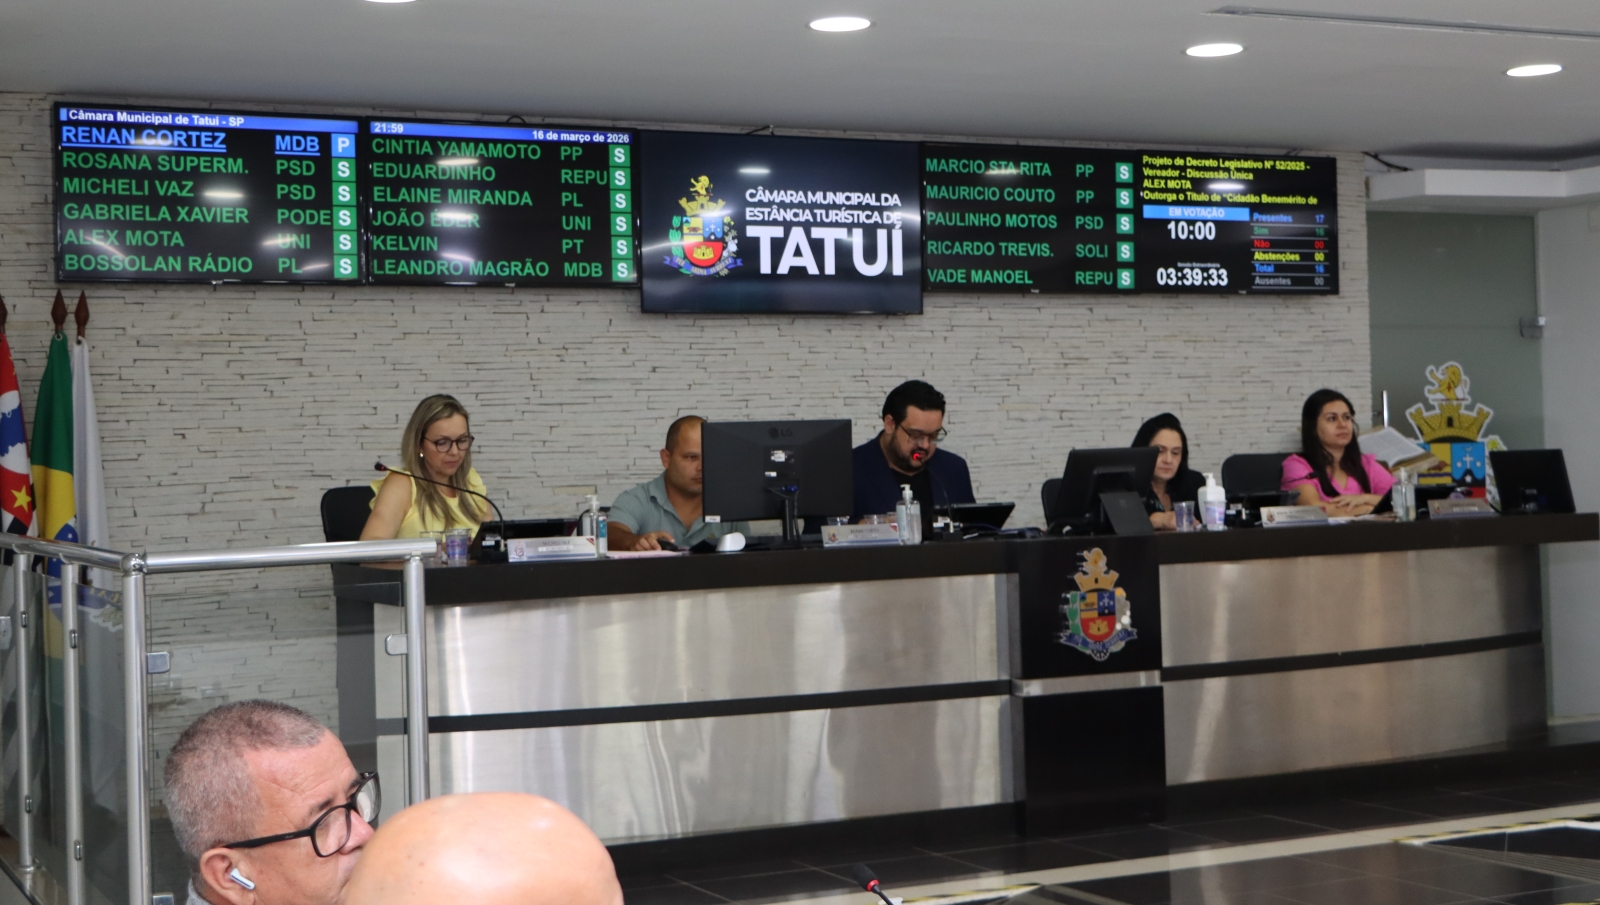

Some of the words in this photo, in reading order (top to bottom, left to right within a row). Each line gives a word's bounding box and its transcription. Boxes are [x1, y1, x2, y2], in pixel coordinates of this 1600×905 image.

[69, 110, 114, 122] Câmara
[117, 112, 172, 125] Municipal
[175, 114, 189, 124] de
[228, 117, 244, 127] SP
[374, 122, 404, 133] 21:59
[62, 126, 135, 144] RENAN
[142, 130, 226, 148] CORTEZ
[276, 136, 320, 152] MDB
[338, 138, 350, 152] P
[532, 131, 544, 139] 16
[546, 131, 558, 139] de
[560, 133, 590, 143] março
[593, 133, 604, 142] de
[607, 134, 629, 143] 2026
[372, 138, 433, 155] CINTIA
[437, 141, 541, 159] YAMAMOTO
[561, 146, 582, 161] PP
[614, 148, 625, 163] S
[63, 152, 152, 170] ROSANA
[158, 156, 248, 174] SUPERM.
[276, 160, 316, 176] PSD
[338, 162, 350, 177] S
[926, 158, 985, 173] MARCIO
[989, 161, 1016, 174] STA
[1020, 162, 1051, 176] RITA
[1076, 164, 1094, 177] PP
[1120, 165, 1129, 179] S
[1143, 155, 1172, 166] Projeto
[1174, 157, 1184, 166] de
[1186, 157, 1218, 167] Decreto
[1220, 158, 1263, 170] Legislativo
[1276, 161, 1305, 170] 52/2025
[373, 162, 496, 181] EDUARDINHO
[561, 170, 608, 185] REPU
[615, 171, 626, 186] S
[1142, 167, 1180, 176] Vereador
[1186, 169, 1229, 179] Discussão
[63, 178, 148, 196] MICHELI
[155, 180, 194, 196] VAZ
[276, 184, 316, 200] PSD
[338, 186, 350, 202] S
[1143, 179, 1166, 188] ALEX
[1167, 179, 1192, 189] MOTA
[373, 187, 442, 203] ELAINE
[448, 189, 532, 206] MIRANDA
[562, 193, 583, 207] PL
[615, 194, 626, 208] S
[746, 186, 806, 204] CÂMARA
[808, 190, 880, 206] MUNICIPAL
[881, 194, 901, 206] DA
[926, 185, 999, 200] MAURICIO
[1004, 188, 1055, 202] COUTO
[1076, 190, 1094, 203] PP
[1120, 191, 1129, 205] S
[1144, 191, 1177, 202] Outorga
[1211, 193, 1221, 201] de
[1262, 194, 1306, 204] Benemérito
[1308, 196, 1318, 204] de
[63, 203, 171, 221] GABRIELA
[177, 206, 248, 223] XAVIER
[277, 208, 332, 225] PODE
[339, 210, 350, 226] S
[373, 209, 424, 226] JOÃO
[431, 209, 480, 228] ÉDER
[562, 216, 591, 230] UNI
[616, 217, 627, 232] S
[746, 206, 812, 222] ESTÂNCIA
[814, 208, 882, 224] TURÍSTICA
[883, 212, 901, 224] DE
[927, 212, 1001, 227] PAULINHO
[1006, 214, 1057, 228] MOTOS
[1076, 216, 1104, 230] PSD
[1120, 217, 1130, 230] S
[1169, 208, 1181, 216] EM
[1184, 206, 1225, 218] VOTAÇÃO
[1253, 212, 1293, 222] Presentes
[1315, 214, 1325, 223] 17
[1168, 220, 1216, 240] 10:00
[1253, 226, 1269, 235] Sim
[64, 229, 119, 246] ALEX
[126, 230, 184, 247] MOTA
[278, 234, 310, 249] UNI
[339, 234, 351, 250] S
[373, 236, 438, 251] KELVIN
[563, 239, 583, 254] PT
[616, 240, 627, 255] S
[1254, 239, 1270, 248] Não
[1314, 240, 1324, 249] 00
[746, 222, 903, 276] TATUÍ
[927, 240, 995, 255] RICARDO
[999, 242, 1054, 257] TREVIS.
[1076, 244, 1108, 258] SOLI
[1121, 245, 1130, 258] S
[1254, 251, 1300, 262] Abstenções
[1314, 252, 1324, 262] 00
[64, 254, 182, 272] BOSSOLAN
[188, 252, 253, 273] RÁDIO
[279, 258, 302, 273] PL
[340, 258, 352, 274] S
[373, 259, 463, 275] LEANDRO
[469, 258, 549, 277] MAGRÃO
[564, 263, 602, 277] MDB
[617, 263, 628, 278] S
[1254, 263, 1274, 272] Total
[927, 269, 966, 283] VADE
[971, 270, 1033, 284] MANOEL
[1075, 272, 1113, 285] REPU
[1121, 272, 1130, 285] S
[1157, 267, 1228, 286] 03:39:33
[1255, 276, 1291, 285] Ausentes
[1314, 277, 1324, 286] 00
[781, 428, 792, 436] LG
